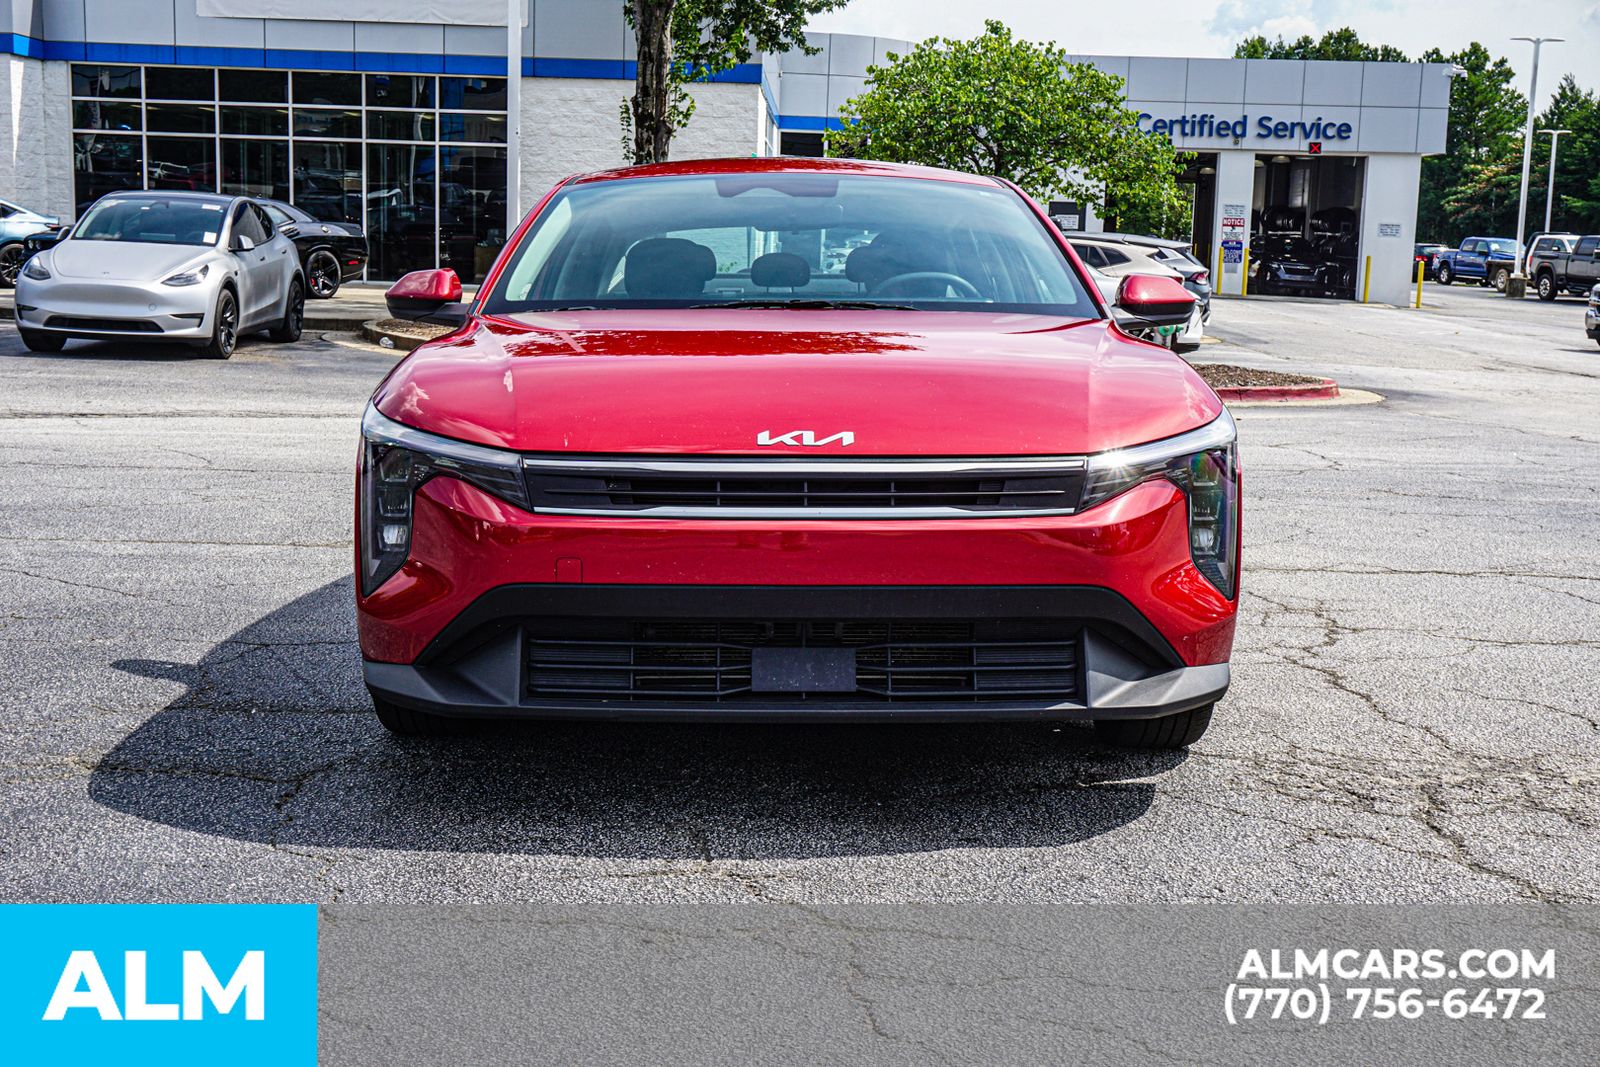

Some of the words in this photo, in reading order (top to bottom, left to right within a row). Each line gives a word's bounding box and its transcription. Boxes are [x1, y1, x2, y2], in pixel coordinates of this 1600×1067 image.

[1136, 113, 1247, 138] Certified
[1256, 116, 1352, 140] Service
[757, 430, 855, 447] KIA
